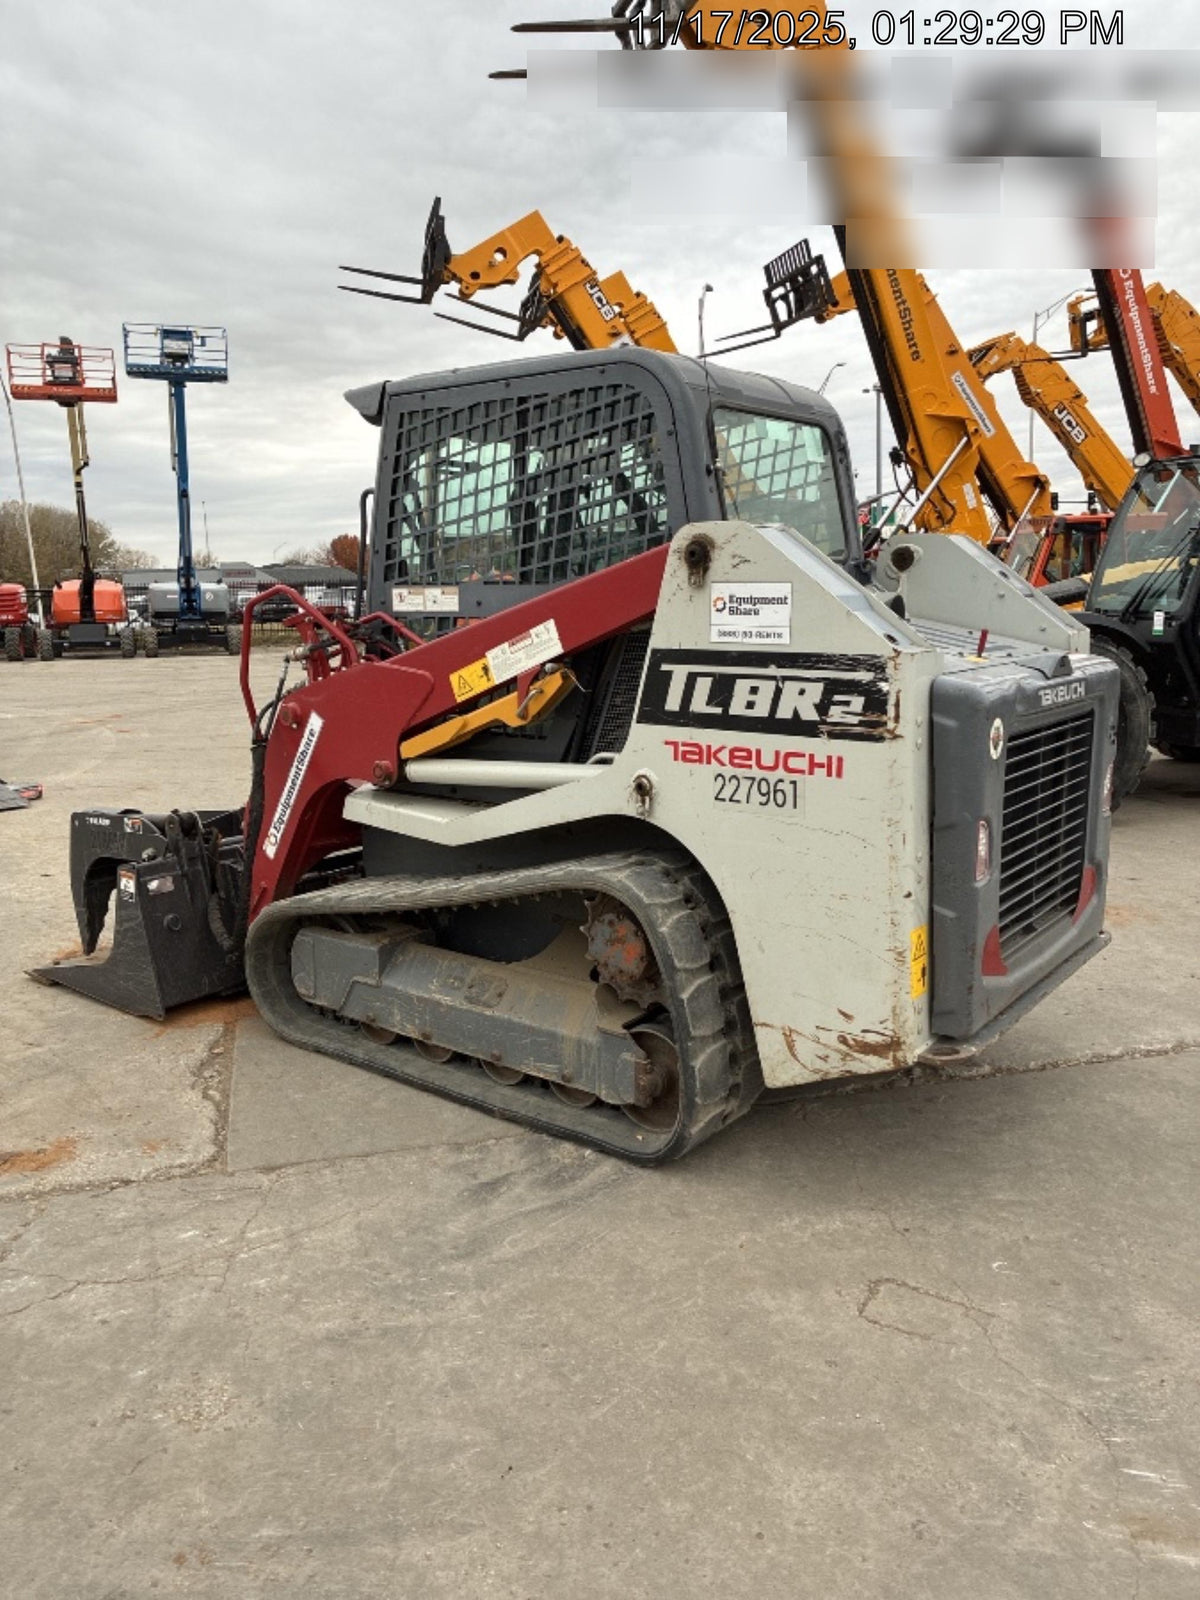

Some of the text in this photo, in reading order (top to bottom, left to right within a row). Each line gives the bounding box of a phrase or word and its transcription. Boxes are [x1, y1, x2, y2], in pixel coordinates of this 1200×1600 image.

[585, 281, 616, 321] JCB
[1123, 280, 1158, 395] EquipmentShare
[1053, 404, 1086, 444] JCB
[728, 594, 789, 607] Equipment
[728, 605, 760, 616] Share
[273, 728, 317, 836] EquipmentShare
[714, 773, 798, 809] 227961
